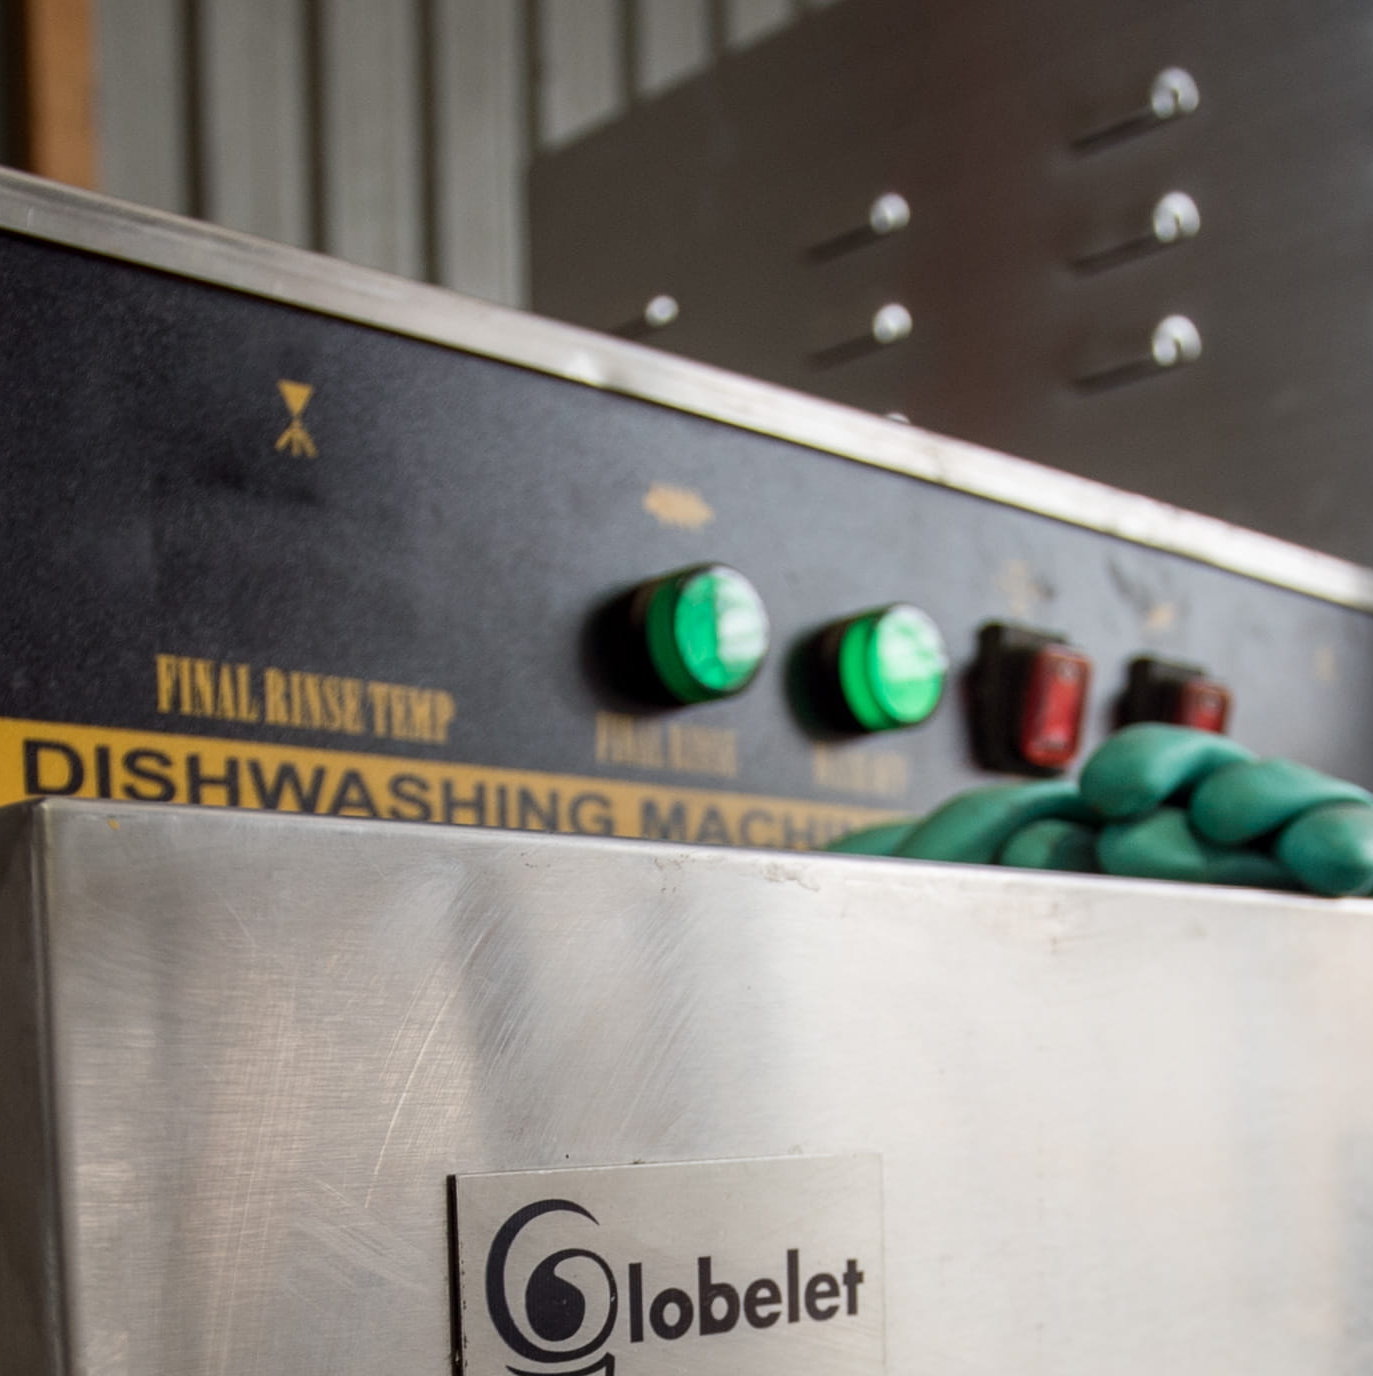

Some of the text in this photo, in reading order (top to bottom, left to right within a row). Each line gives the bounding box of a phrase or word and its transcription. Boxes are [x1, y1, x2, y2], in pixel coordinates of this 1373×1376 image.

[156, 653, 455, 744] FINAL RINSE TEMP
[23, 737, 614, 837] DISHWASHING
[640, 799, 850, 850] MACHI
